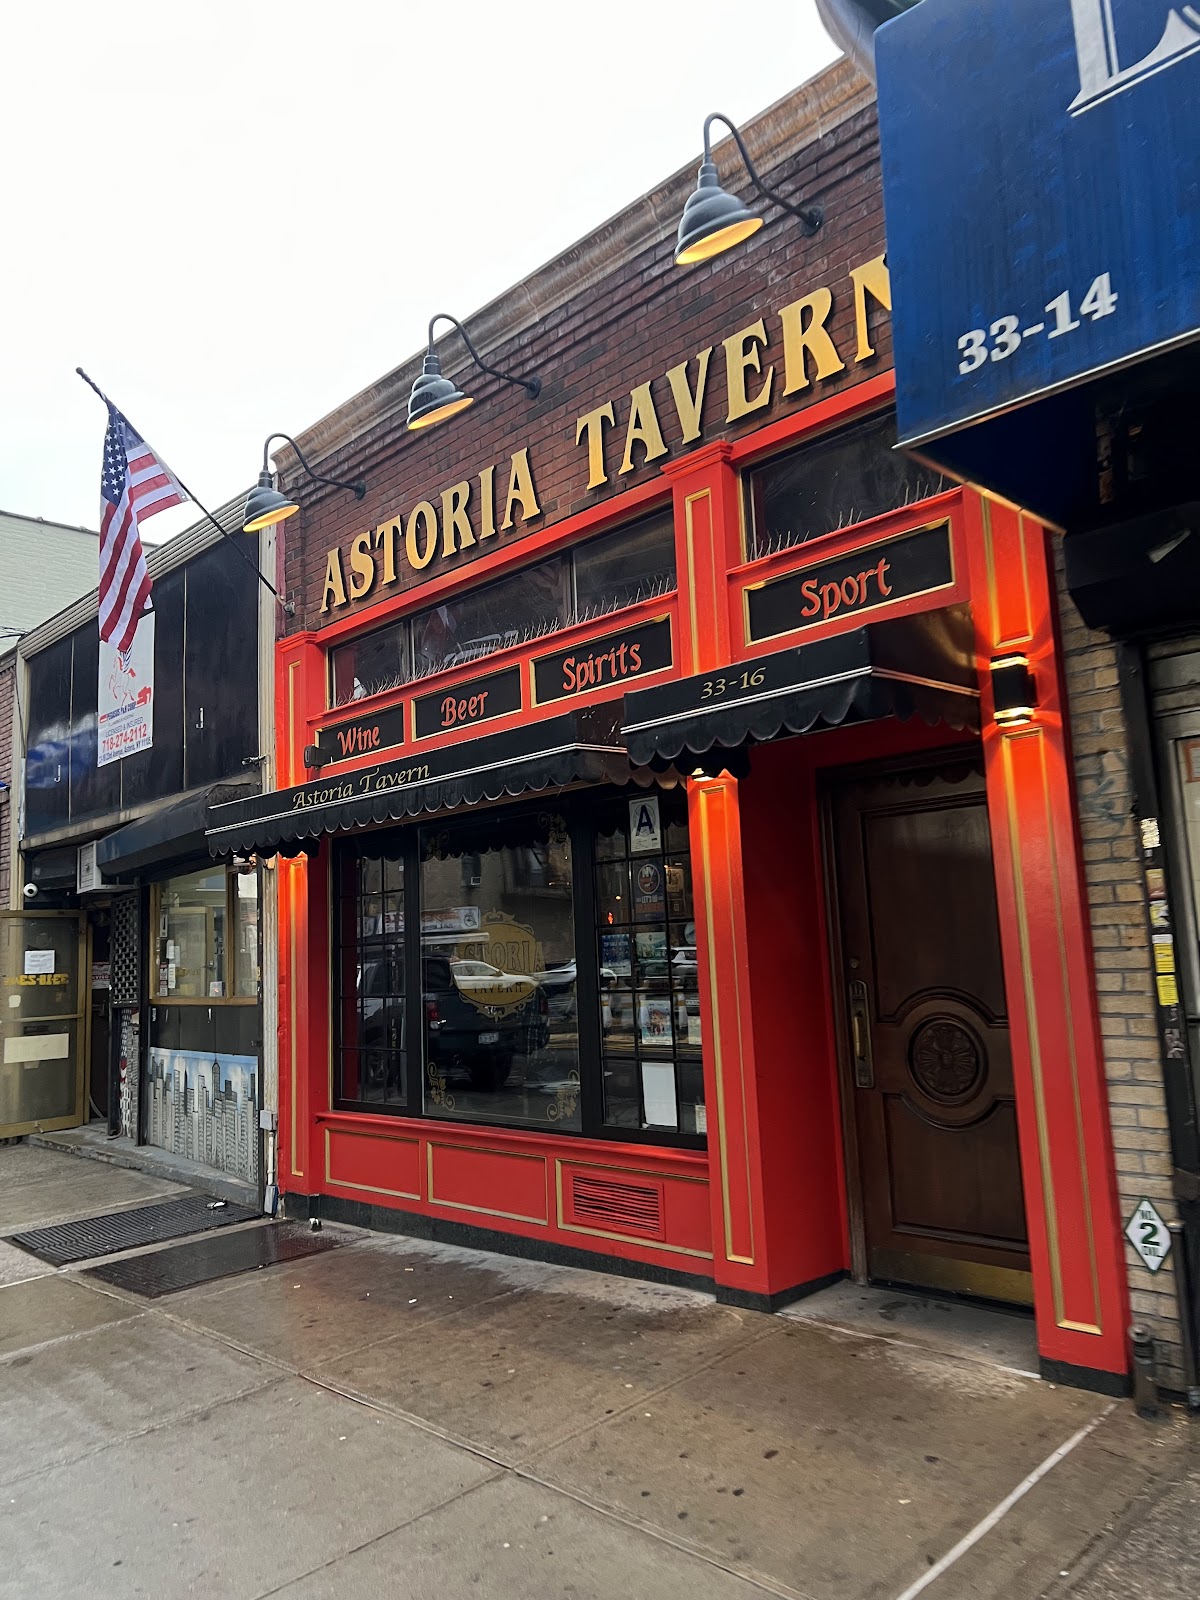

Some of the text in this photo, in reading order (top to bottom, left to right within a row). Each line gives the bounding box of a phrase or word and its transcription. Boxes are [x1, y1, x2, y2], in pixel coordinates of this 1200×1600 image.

[957, 271, 1119, 375] 33-14
[319, 447, 541, 613] ASTORIA
[800, 557, 893, 619] Sport
[562, 641, 642, 692] Spirits
[700, 667, 767, 700] 33-16
[127, 717, 143, 729] INSURED
[440, 692, 489, 727] Beer
[102, 723, 147, 753] 718-274-2112
[337, 726, 380, 756] Wine
[293, 764, 430, 810] Astoria Tavern
[635, 804, 655, 837] A
[1140, 1222, 1160, 1247] 2
